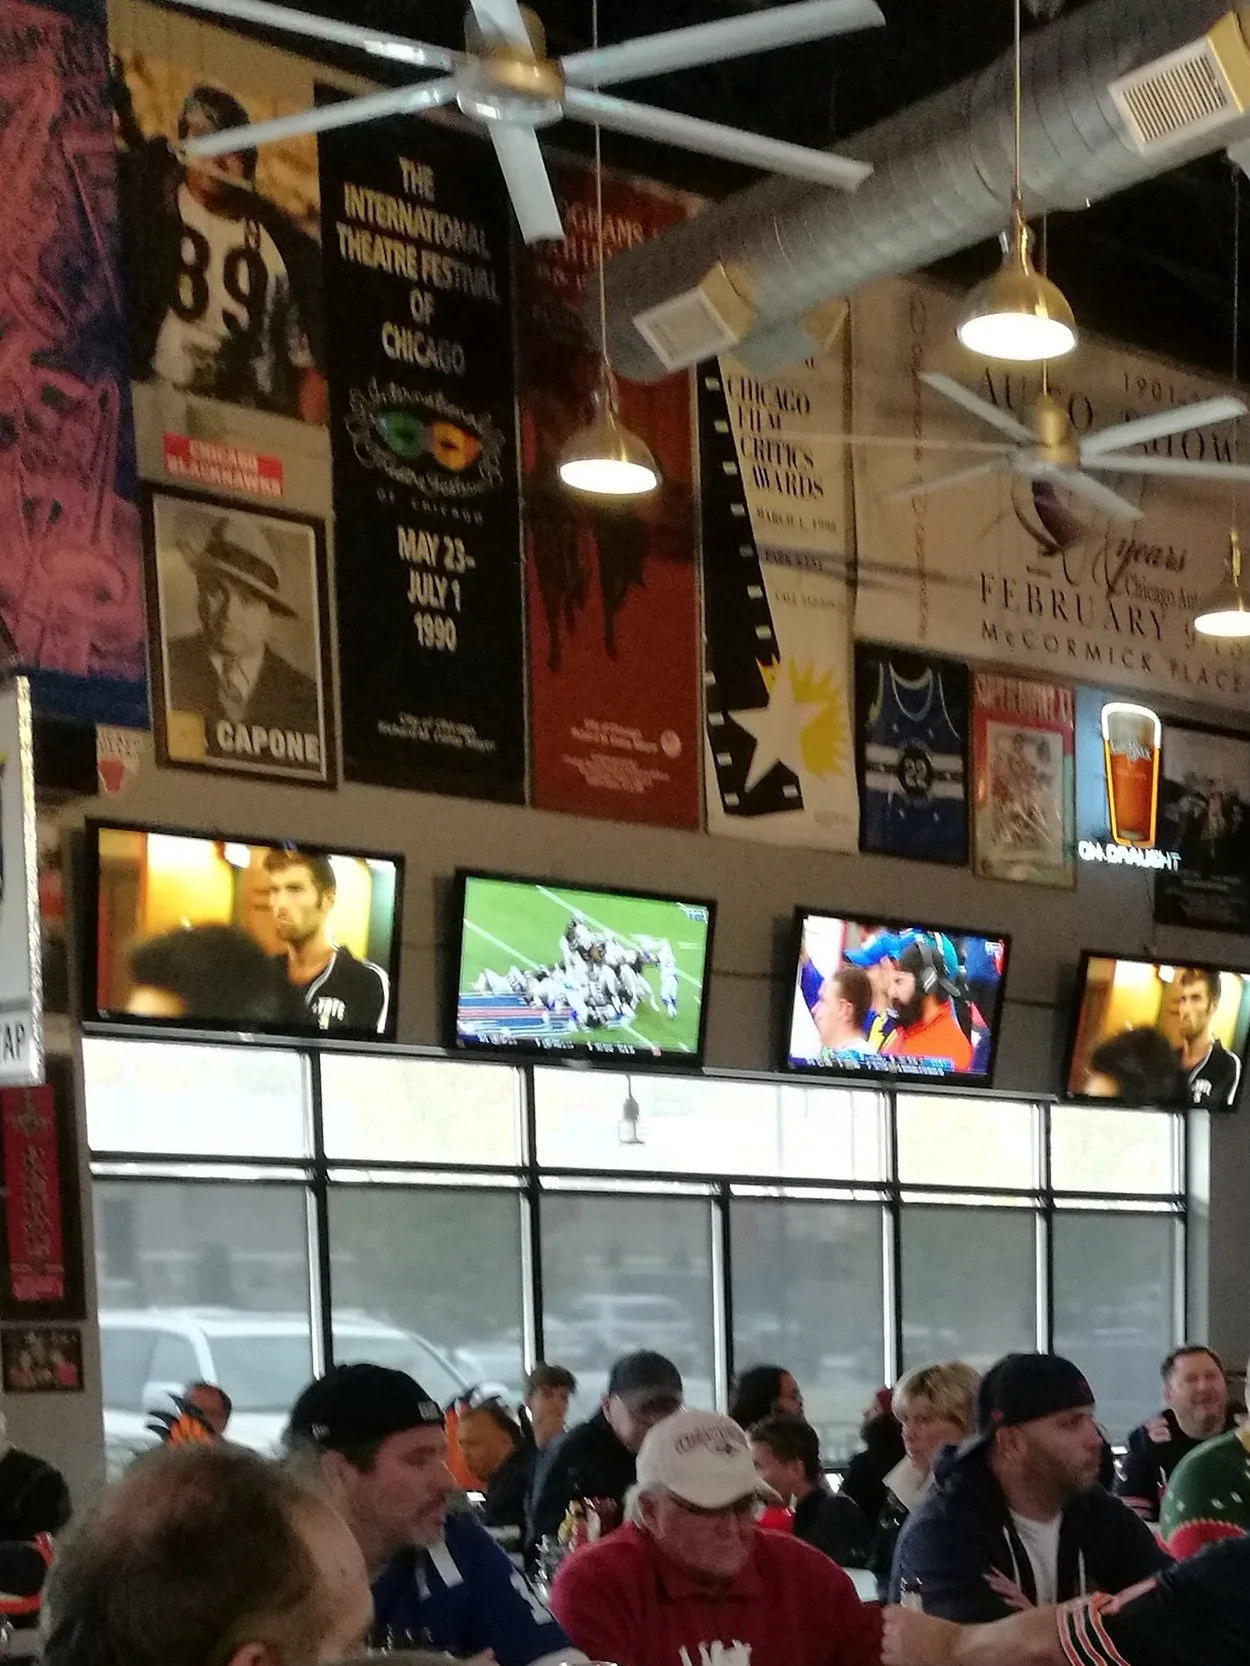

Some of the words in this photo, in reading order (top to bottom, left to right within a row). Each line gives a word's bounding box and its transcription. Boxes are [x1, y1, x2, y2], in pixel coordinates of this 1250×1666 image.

[399, 155, 435, 201] THE
[343, 181, 491, 260] INTERNATIONAL
[335, 220, 418, 282] THEATRE
[420, 248, 499, 303] FESTIVAL
[409, 286, 435, 326] OF
[381, 319, 466, 378] CHICAGO
[727, 375, 811, 415] CHICAGO
[738, 404, 782, 433] FILM
[740, 436, 816, 481] CRITICS
[398, 524, 440, 569] MAY
[408, 568, 449, 611] JULY
[452, 578, 463, 613] 1
[978, 571, 1169, 643] FEBRUARY
[413, 611, 459, 653] 1990
[1169, 655, 1244, 694] PLACE
[217, 719, 320, 764] CAPONE
